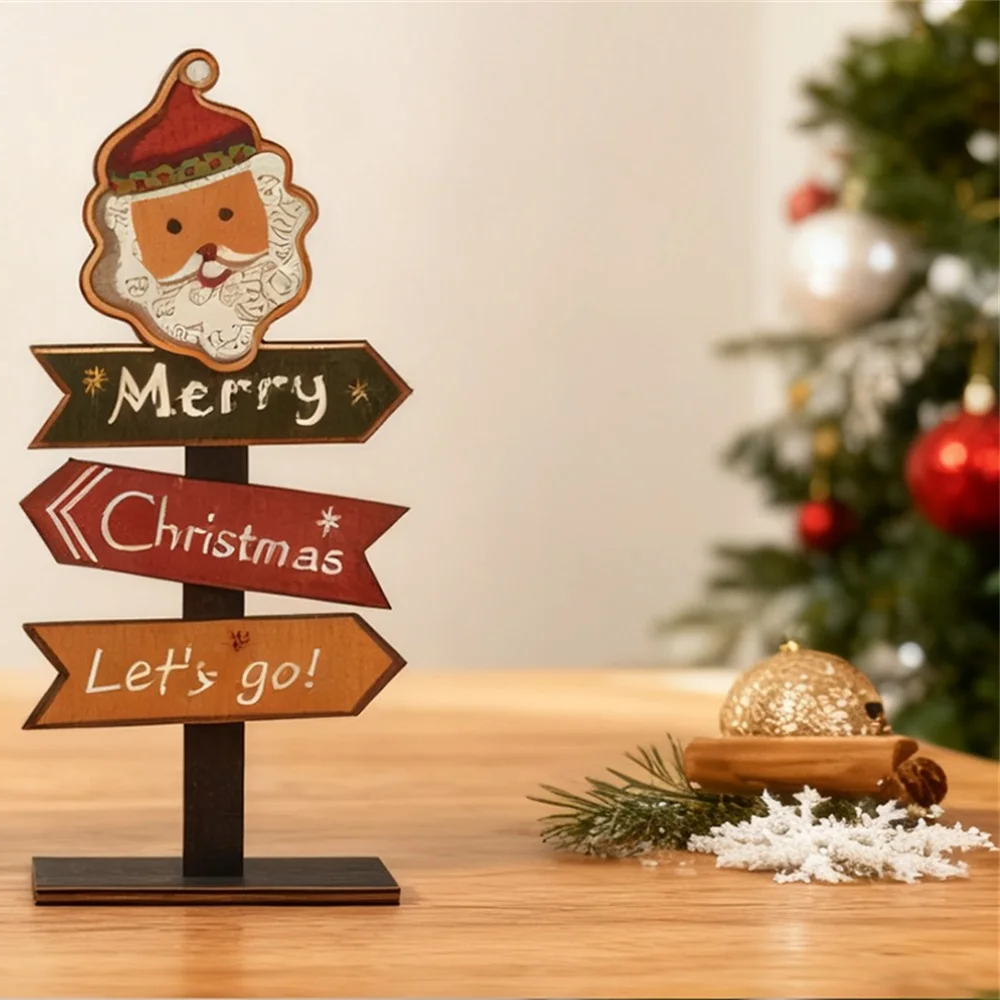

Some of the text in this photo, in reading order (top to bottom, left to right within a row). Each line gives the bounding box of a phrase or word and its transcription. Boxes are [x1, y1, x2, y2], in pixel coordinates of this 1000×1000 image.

[108, 362, 328, 426] Merry
[101, 490, 344, 576] Christmas
[236, 648, 321, 706] go!
